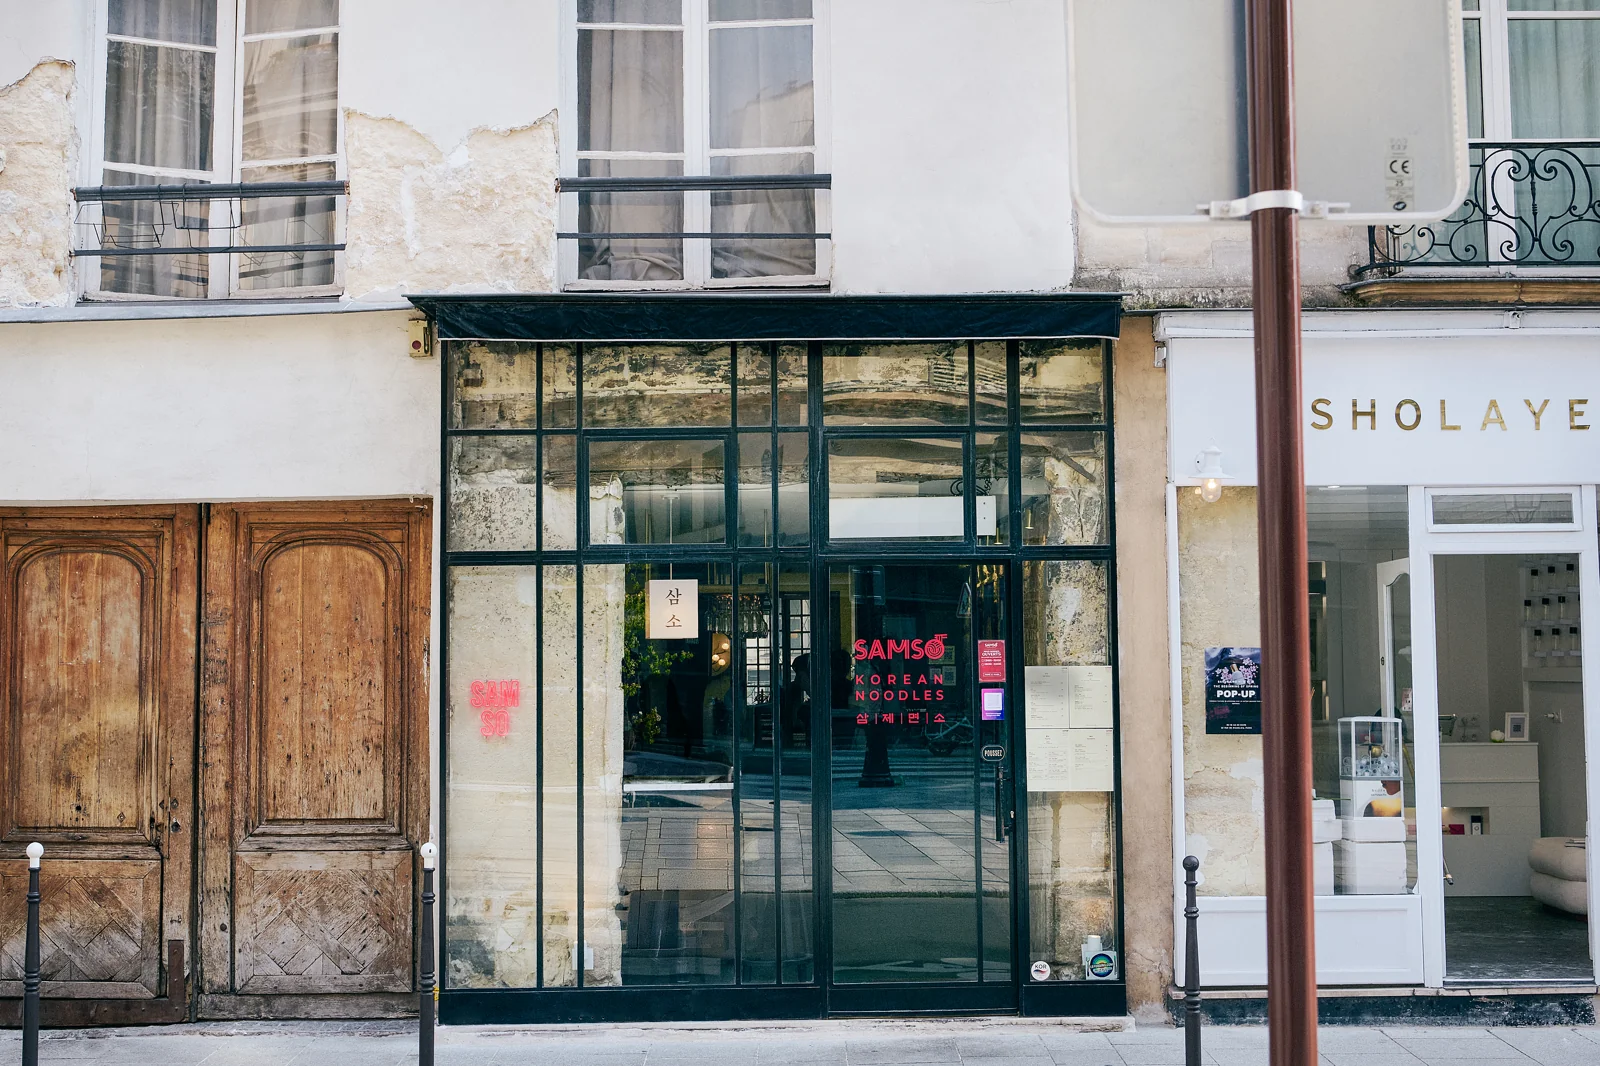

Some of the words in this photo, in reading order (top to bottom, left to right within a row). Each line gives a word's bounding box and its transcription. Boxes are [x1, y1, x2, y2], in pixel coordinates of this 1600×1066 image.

[1389, 160, 1409, 174] CE
[1310, 397, 1591, 431] SHOLAYE
[855, 674, 943, 685] KOREAN
[470, 679, 520, 708] SAM
[855, 690, 944, 701] NOODLES
[1216, 690, 1256, 698] POP-UP
[480, 709, 510, 737] SO
[984, 749, 1003, 757] POUSSEZ
